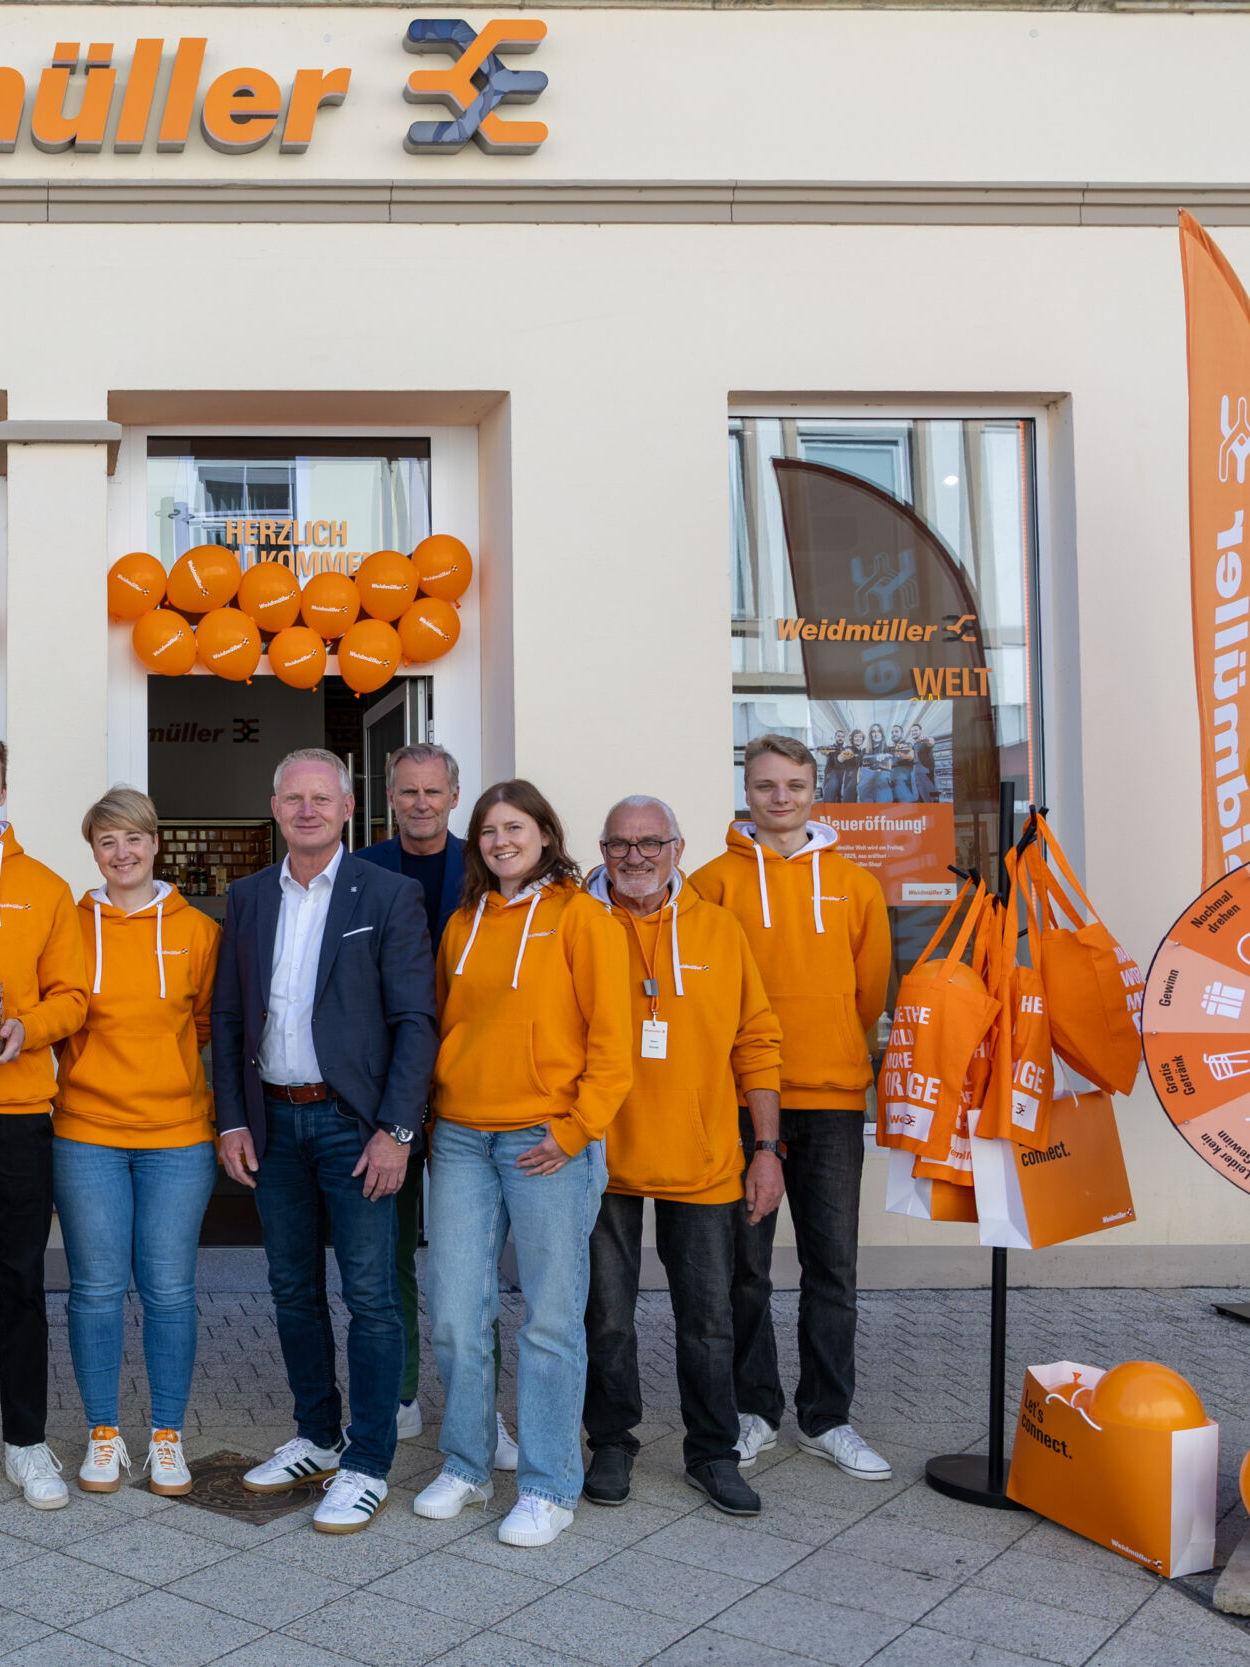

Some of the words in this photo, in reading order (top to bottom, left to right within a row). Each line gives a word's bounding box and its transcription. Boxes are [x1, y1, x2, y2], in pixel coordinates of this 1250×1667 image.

[226, 519, 348, 545] HERZLICH
[776, 618, 938, 642] Weidmüller
[913, 667, 993, 697] WELT
[148, 721, 225, 743] müller
[1190, 889, 1234, 929] Nochmal
[1207, 903, 1242, 934] drehen
[1158, 968, 1180, 1007] Gewinn
[1021, 995, 1044, 1014] HE
[1159, 1062, 1179, 1094] Gratis
[1171, 1055, 1196, 1096] Getränk
[1200, 1132, 1222, 1155] kein
[1024, 1389, 1044, 1424] Let's
[1021, 1413, 1073, 1460] connect.
[1111, 1538, 1152, 1564] Weidmüller
